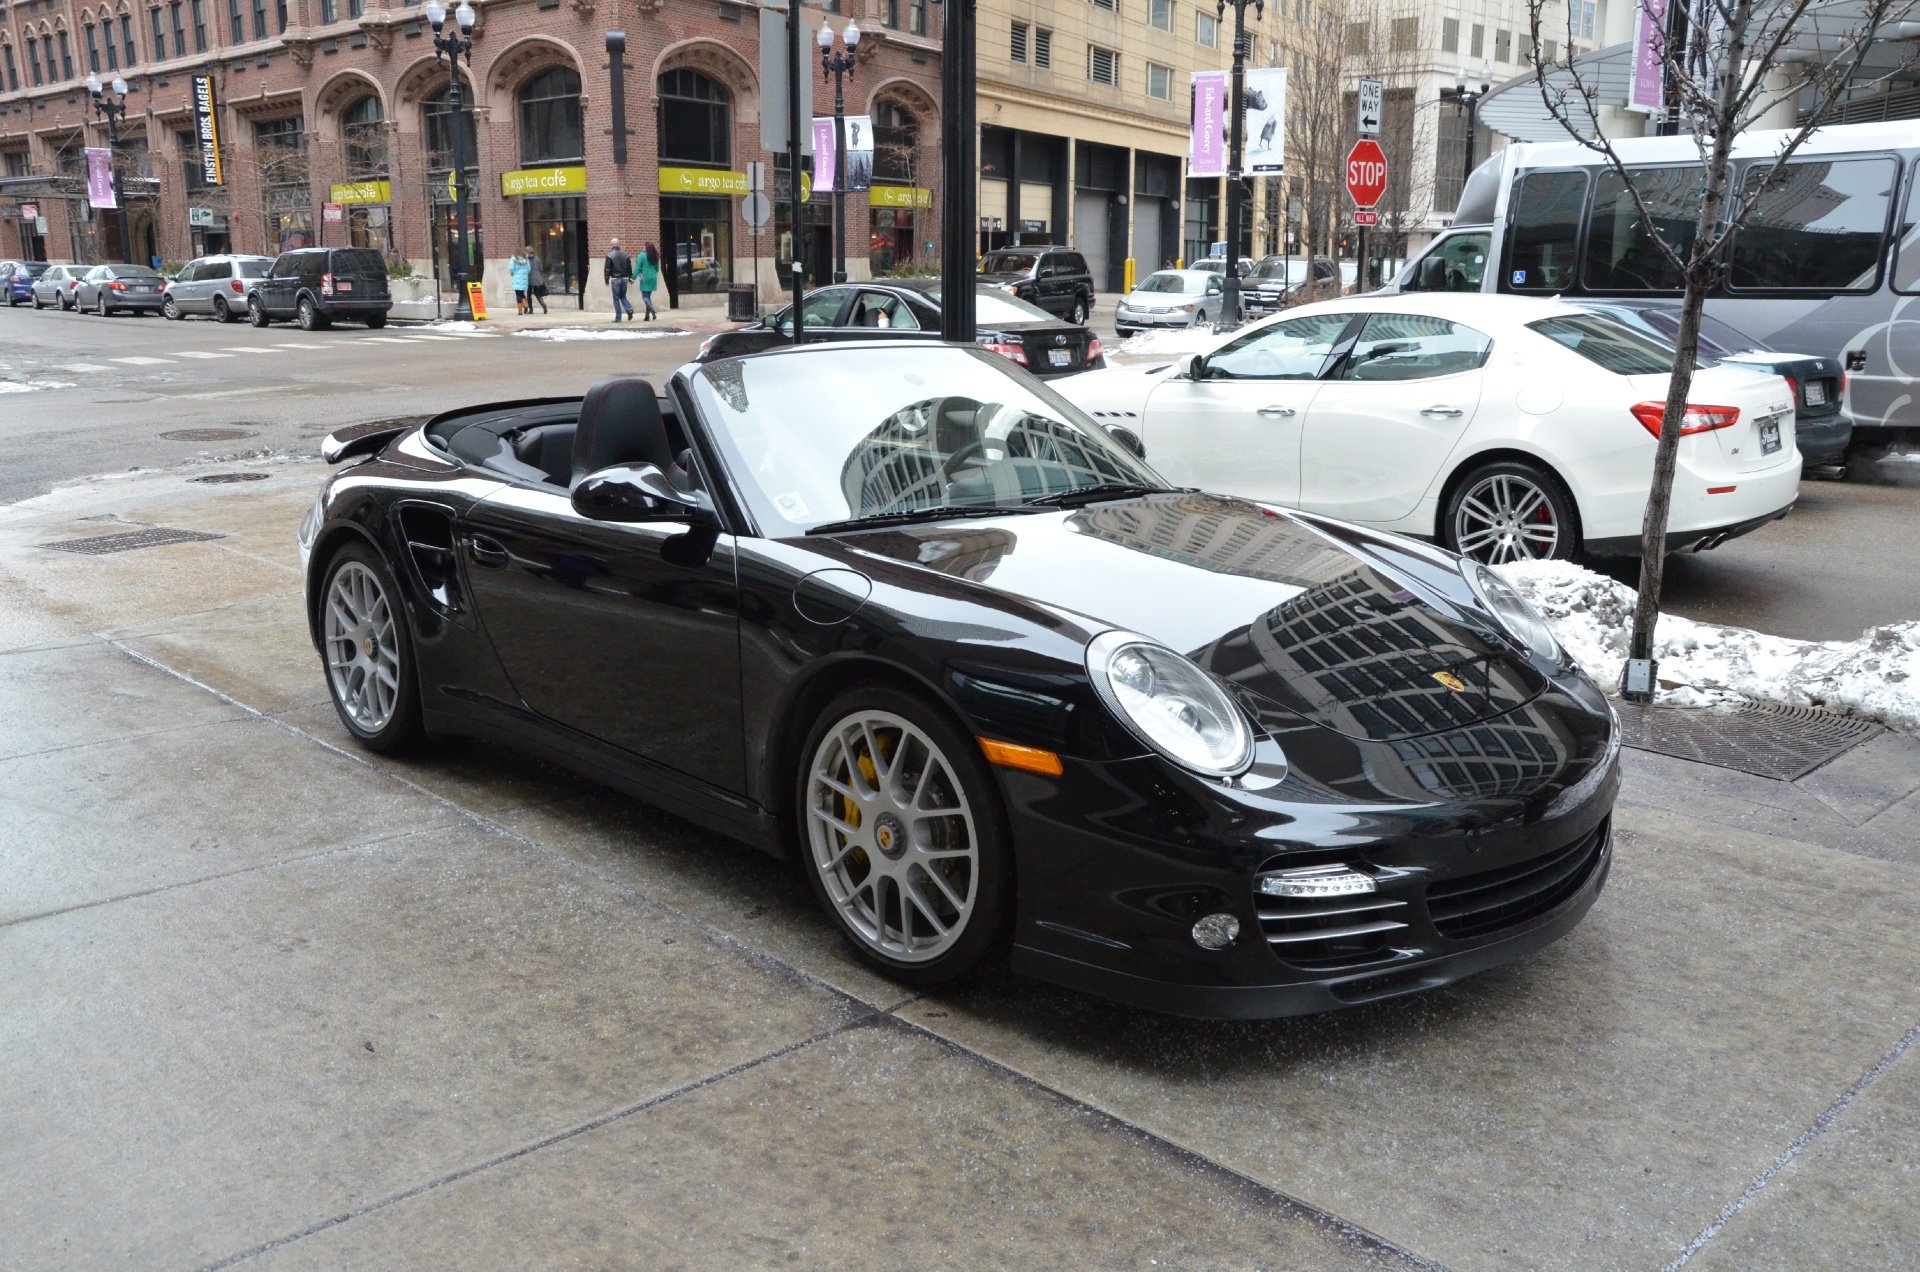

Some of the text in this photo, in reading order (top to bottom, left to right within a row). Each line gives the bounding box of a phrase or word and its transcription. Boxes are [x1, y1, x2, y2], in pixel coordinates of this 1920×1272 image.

[1362, 84, 1379, 98] ONE
[1204, 87, 1215, 123] Edward
[1361, 100, 1379, 113] WAY
[196, 77, 218, 184] EINSTEIN BROS. BAGELS
[1201, 124, 1214, 155] Gorey
[525, 176, 538, 188] tea
[541, 169, 567, 187] café
[1349, 161, 1385, 187] STOP
[698, 177, 720, 191] argo
[722, 177, 733, 189] tea
[1356, 214, 1364, 223] ALL
[1365, 214, 1375, 223] WAY
